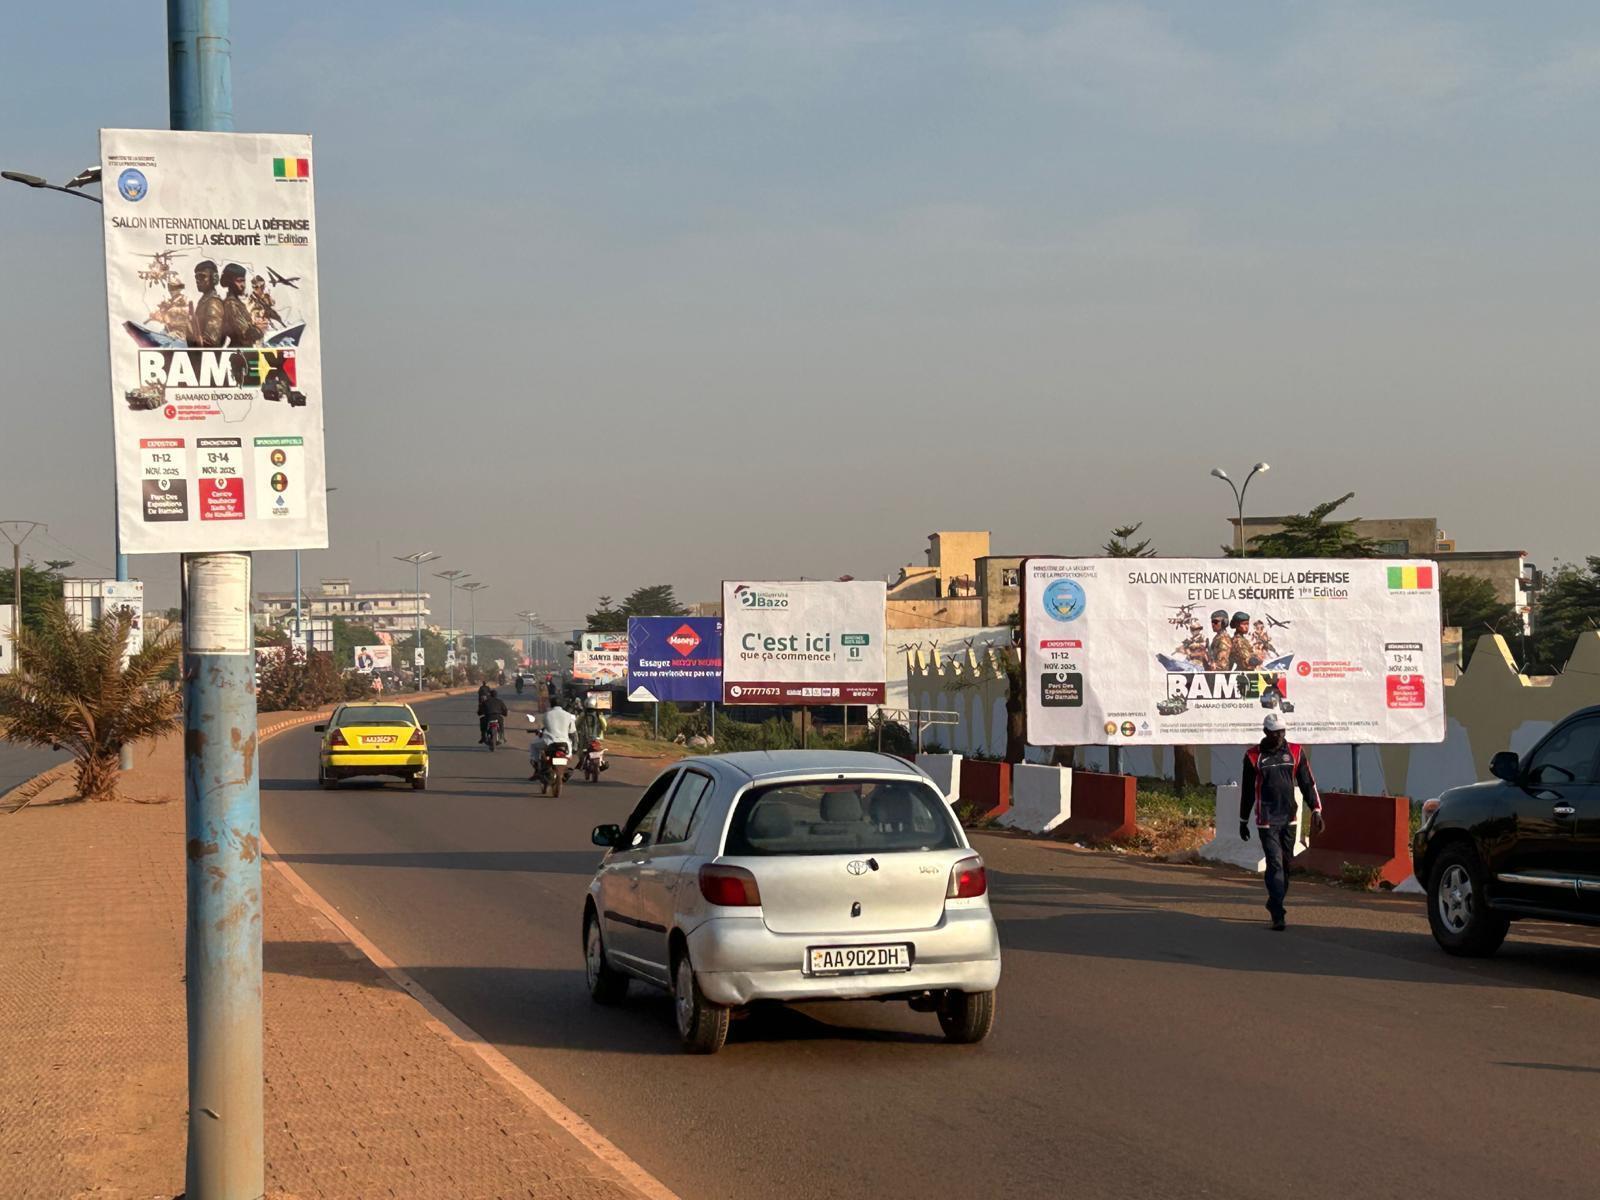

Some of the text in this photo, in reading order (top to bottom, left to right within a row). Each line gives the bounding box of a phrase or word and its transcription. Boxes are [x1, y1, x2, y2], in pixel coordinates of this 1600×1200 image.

[112, 216, 310, 231] SALON INTERNATIONAL DE LA DÉFENSE
[165, 233, 178, 245] ET
[180, 233, 194, 245] DE
[195, 233, 209, 245] LA
[210, 232, 261, 246] SÉCURITÉ
[277, 233, 309, 244] Edition
[175, 393, 210, 401] BAMAKO
[211, 393, 233, 401] EXPO
[152, 453, 171, 462] 11-12
[208, 452, 229, 463] 13-14
[1128, 570, 1350, 584] SALON INTERNATIONAL DE LA DÉFENSE
[1188, 588, 1202, 600] ET
[1204, 588, 1220, 600] DE
[1221, 588, 1237, 600] LA
[1238, 586, 1295, 600] SÉCURITÉ
[1313, 586, 1348, 597] Edition
[757, 597, 789, 607] Bazo
[742, 633, 798, 652] C'est
[806, 633, 831, 652] ici
[740, 652, 760, 661] que
[762, 652, 773, 662] ça
[776, 653, 831, 661] commence
[1051, 652, 1069, 660] 11-12
[1393, 654, 1412, 663] 13-14
[640, 658, 671, 668] Essayez
[1060, 663, 1076, 671] 2025
[742, 687, 781, 696] 77777673
